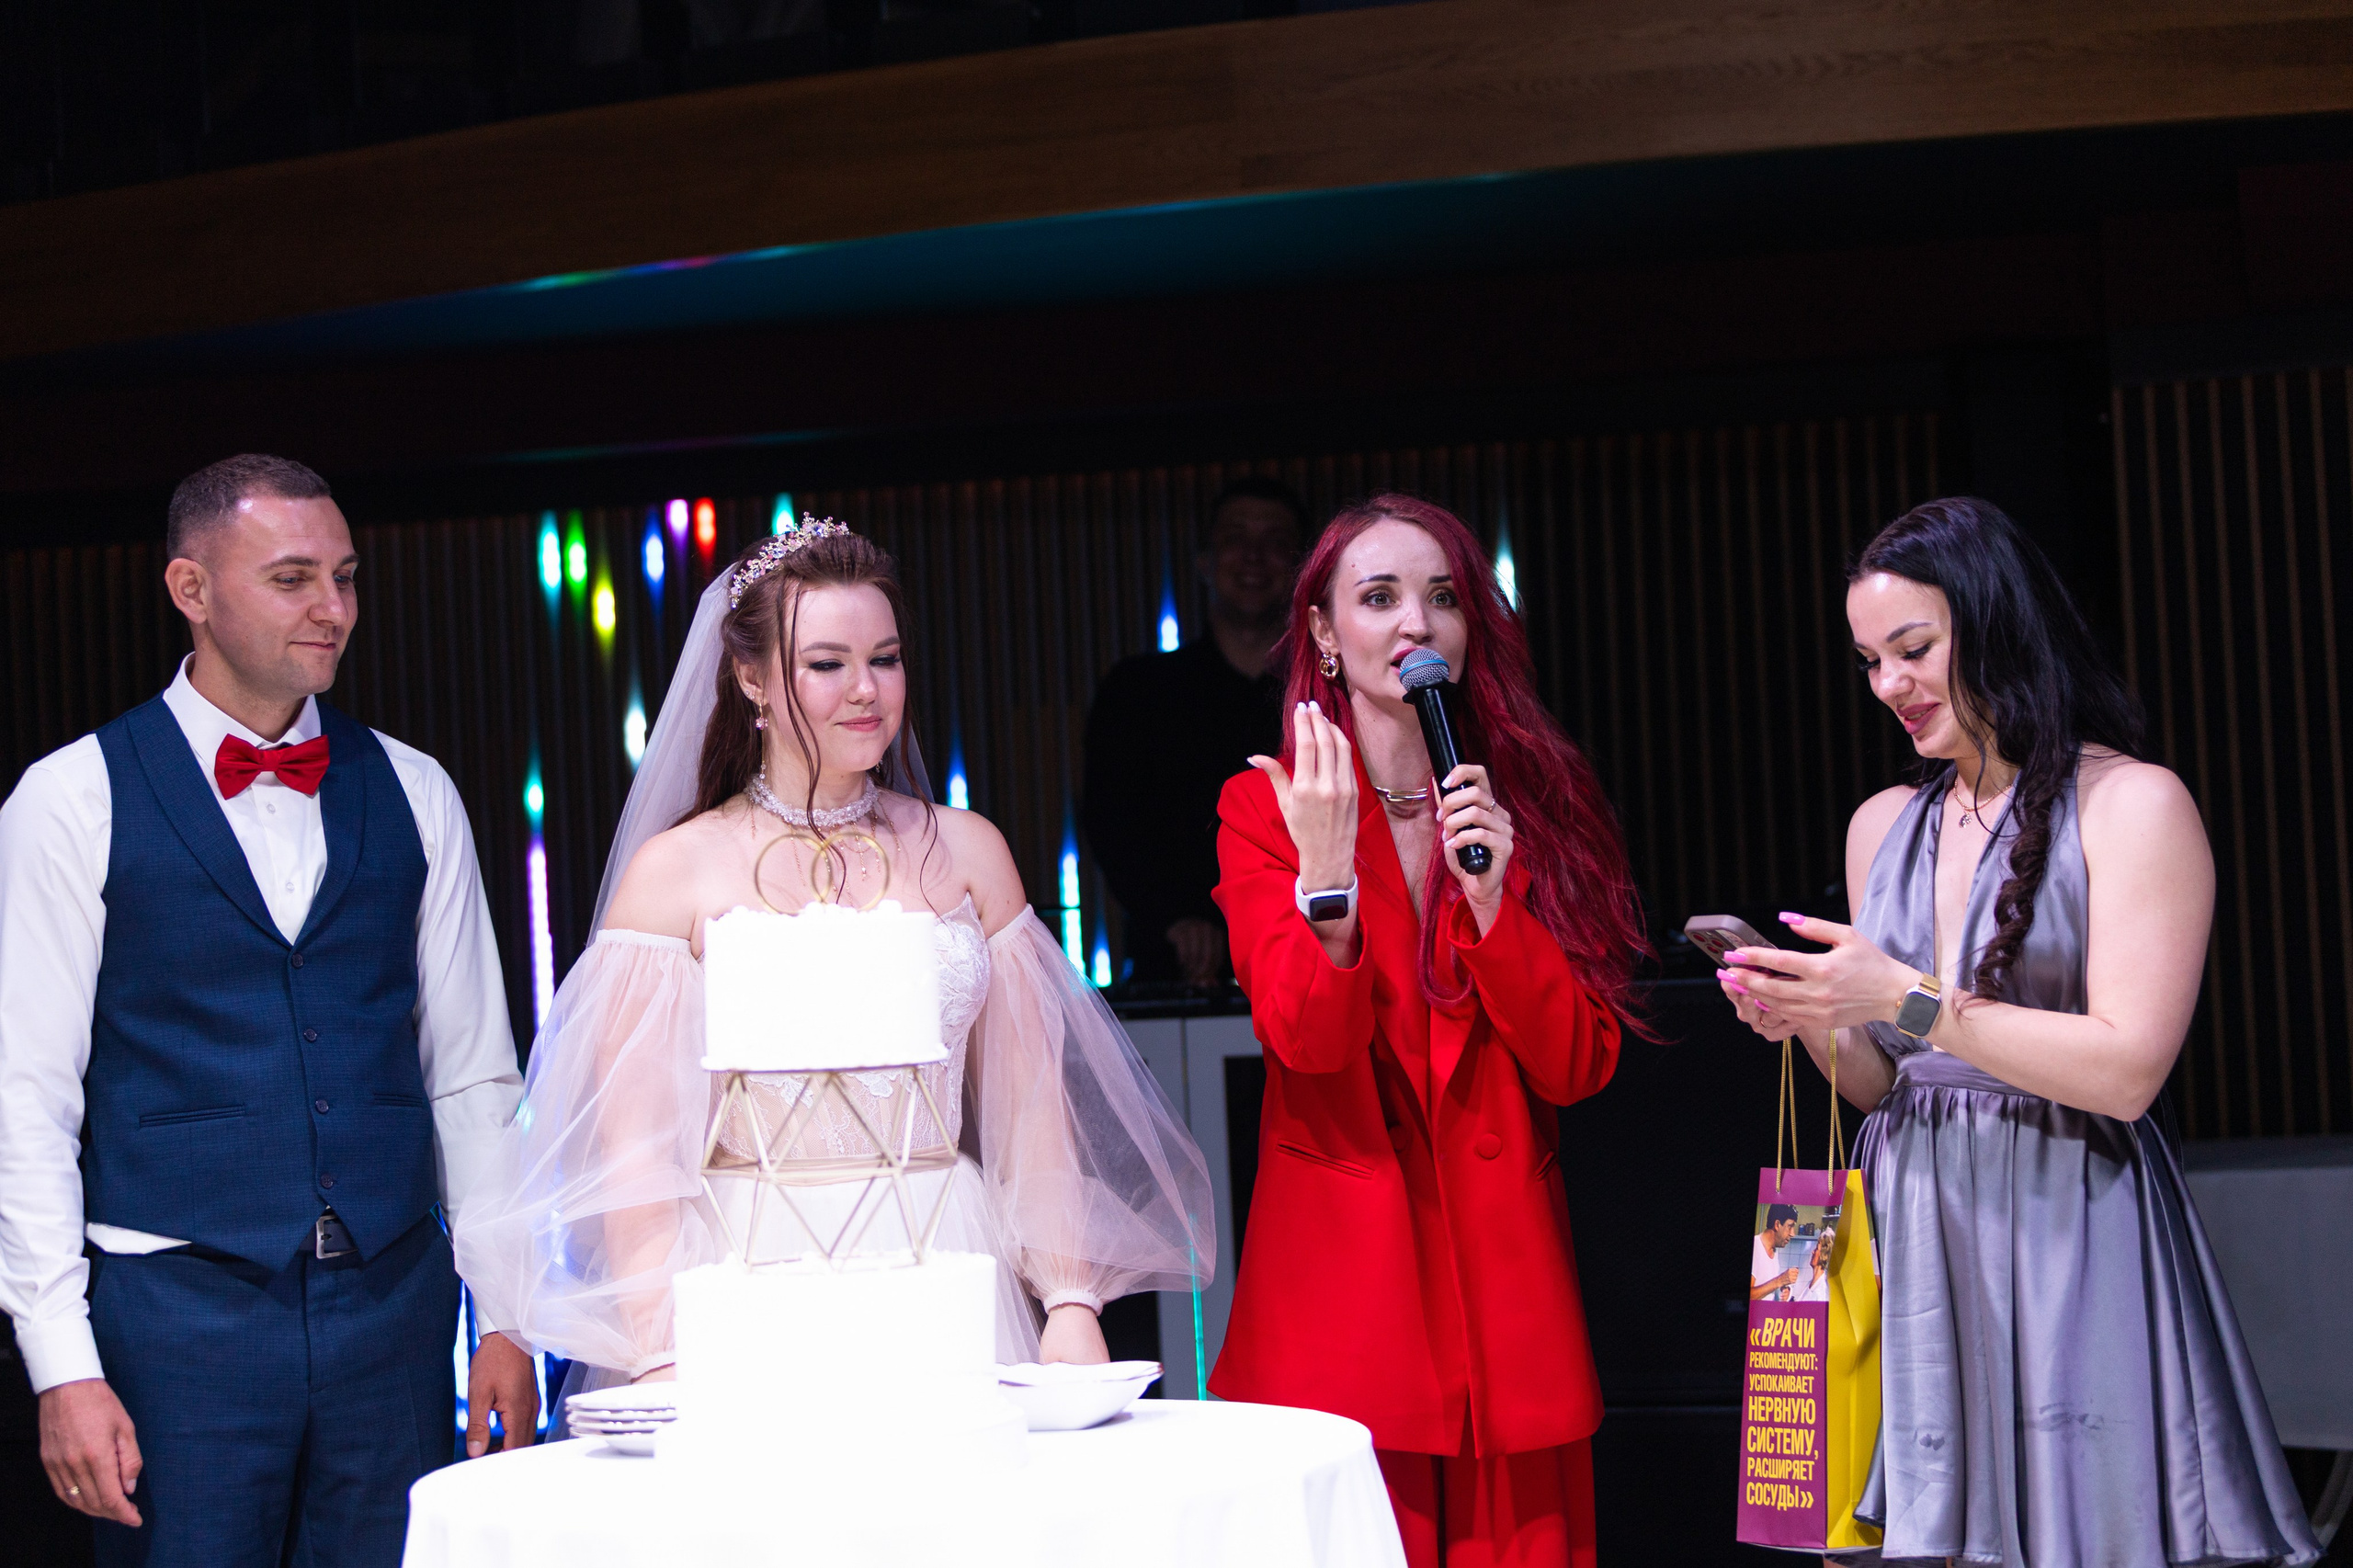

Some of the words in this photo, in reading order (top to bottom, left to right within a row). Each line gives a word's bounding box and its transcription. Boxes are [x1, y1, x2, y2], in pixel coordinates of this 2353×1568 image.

[1749, 1317, 1815, 1348] «ВРАЧИ
[1749, 1351, 1818, 1372] РЕКОМЕНДУЮТ:
[1748, 1373, 1814, 1393] УСПОКАИВАЕТ
[1747, 1395, 1816, 1425] НЕРВНУЮ
[1746, 1426, 1819, 1460] СИСТЕМУ,
[1746, 1457, 1815, 1481] РАСШИРЯЕТ
[1745, 1482, 1814, 1511] СОСУДЫ»
